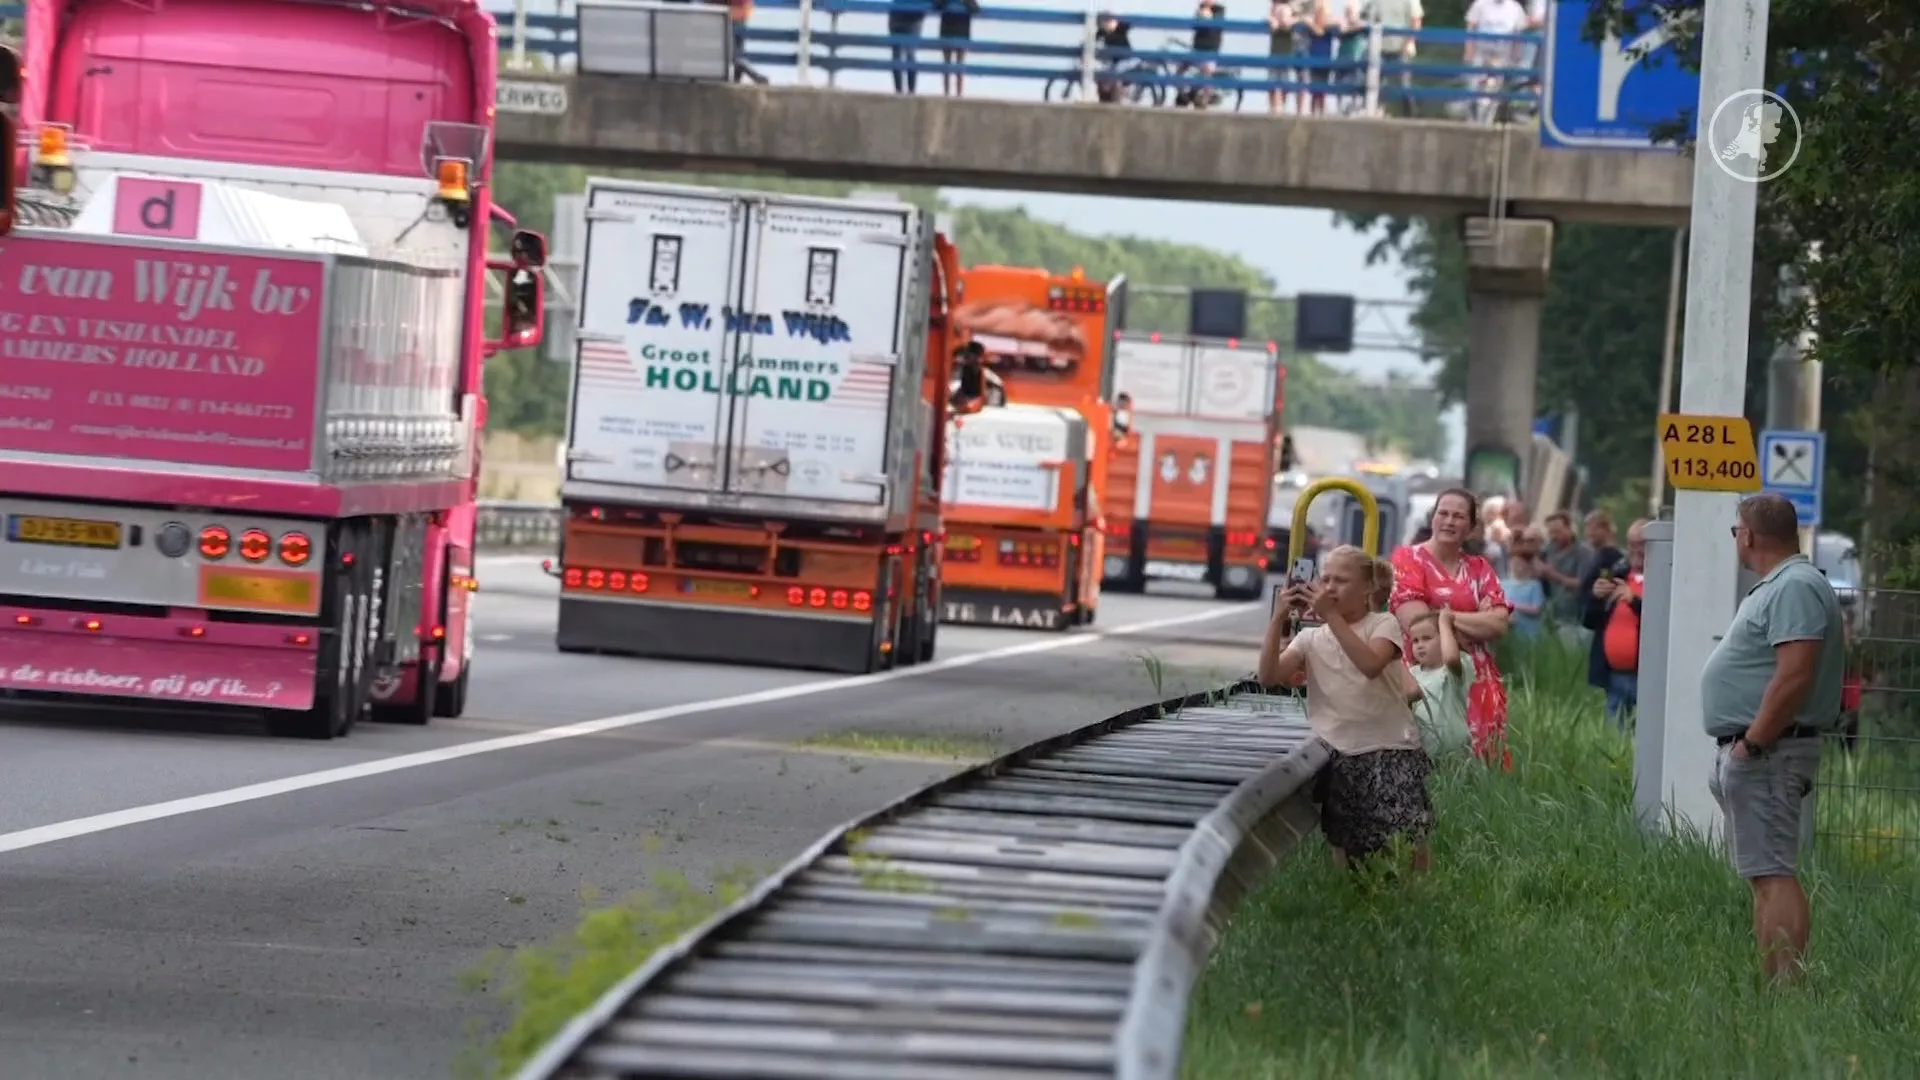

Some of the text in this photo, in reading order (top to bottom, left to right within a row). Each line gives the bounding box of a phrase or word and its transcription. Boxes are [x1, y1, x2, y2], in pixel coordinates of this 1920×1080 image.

[140, 189, 174, 231] d
[19, 264, 114, 300] van
[134, 259, 238, 322] Wijk
[641, 343, 711, 365] Groot
[738, 353, 840, 375] Ammers
[646, 366, 831, 402] HOLLAND
[1664, 423, 1736, 445] A 28 L
[1671, 456, 1756, 481] 113,400
[991, 605, 1059, 629] LAAT
